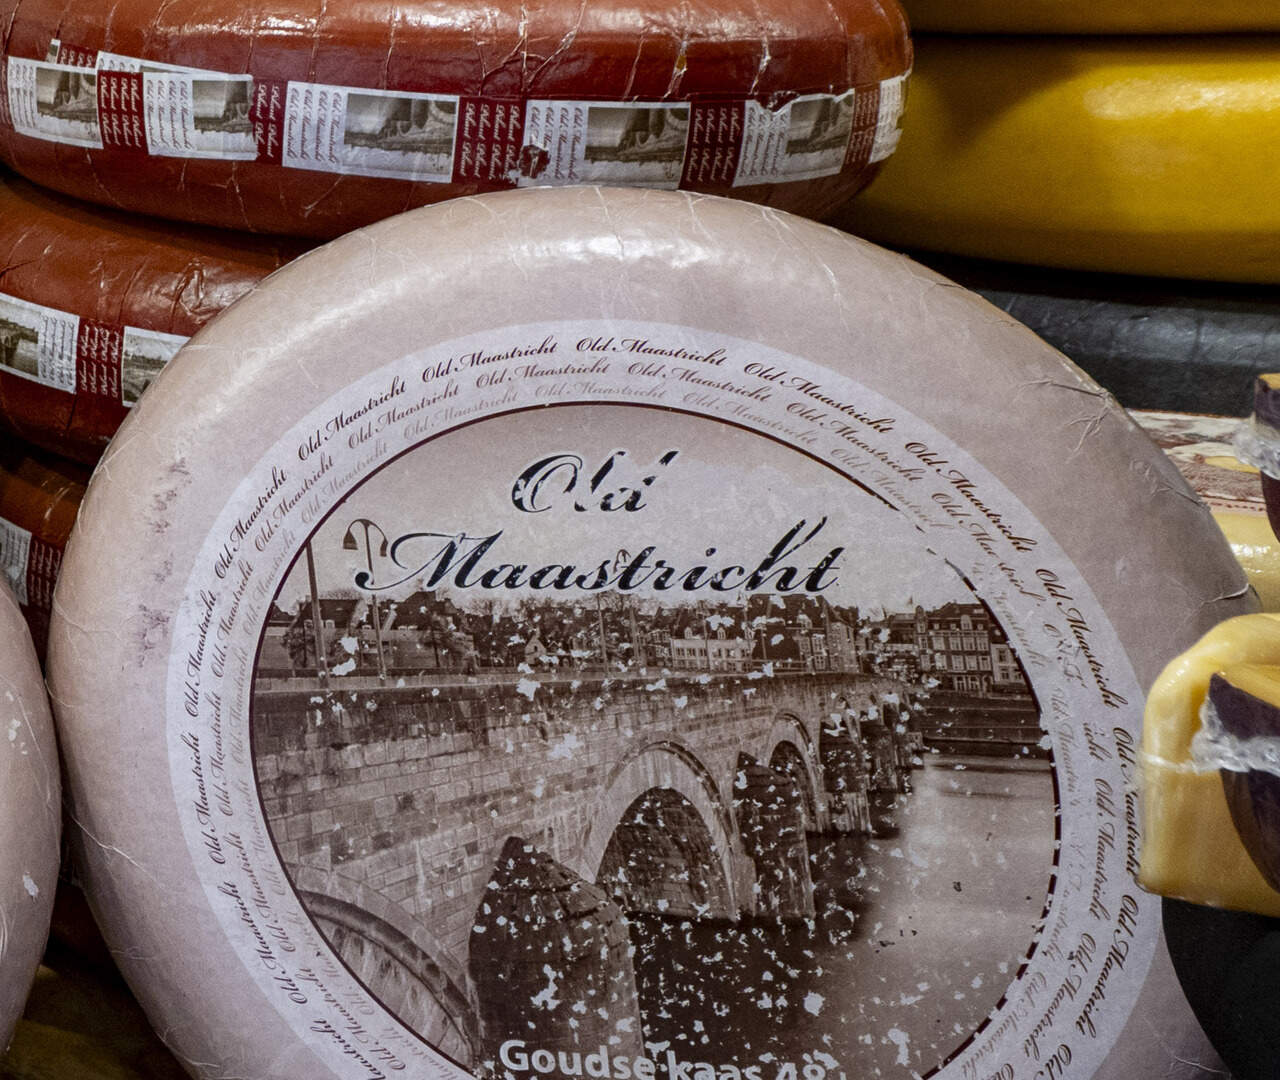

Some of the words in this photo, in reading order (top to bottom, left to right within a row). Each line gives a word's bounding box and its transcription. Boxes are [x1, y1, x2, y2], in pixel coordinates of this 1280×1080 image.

[421, 357, 450, 384] Old
[457, 334, 558, 374] Maastricht
[576, 336, 610, 356] Old
[612, 337, 727, 367] Maastricht
[297, 433, 322, 462] Old
[324, 375, 407, 441] Maastricht
[744, 361, 779, 385] Old
[781, 375, 897, 435] Maastricht
[511, 450, 679, 513] Old
[905, 440, 942, 471] Old
[941, 467, 1038, 554] Maastricht
[354, 516, 845, 592] Maastricht
[1035, 567, 1062, 609] Old
[1061, 606, 1130, 712] Maastricht
[499, 1039, 655, 1080] Goudse
